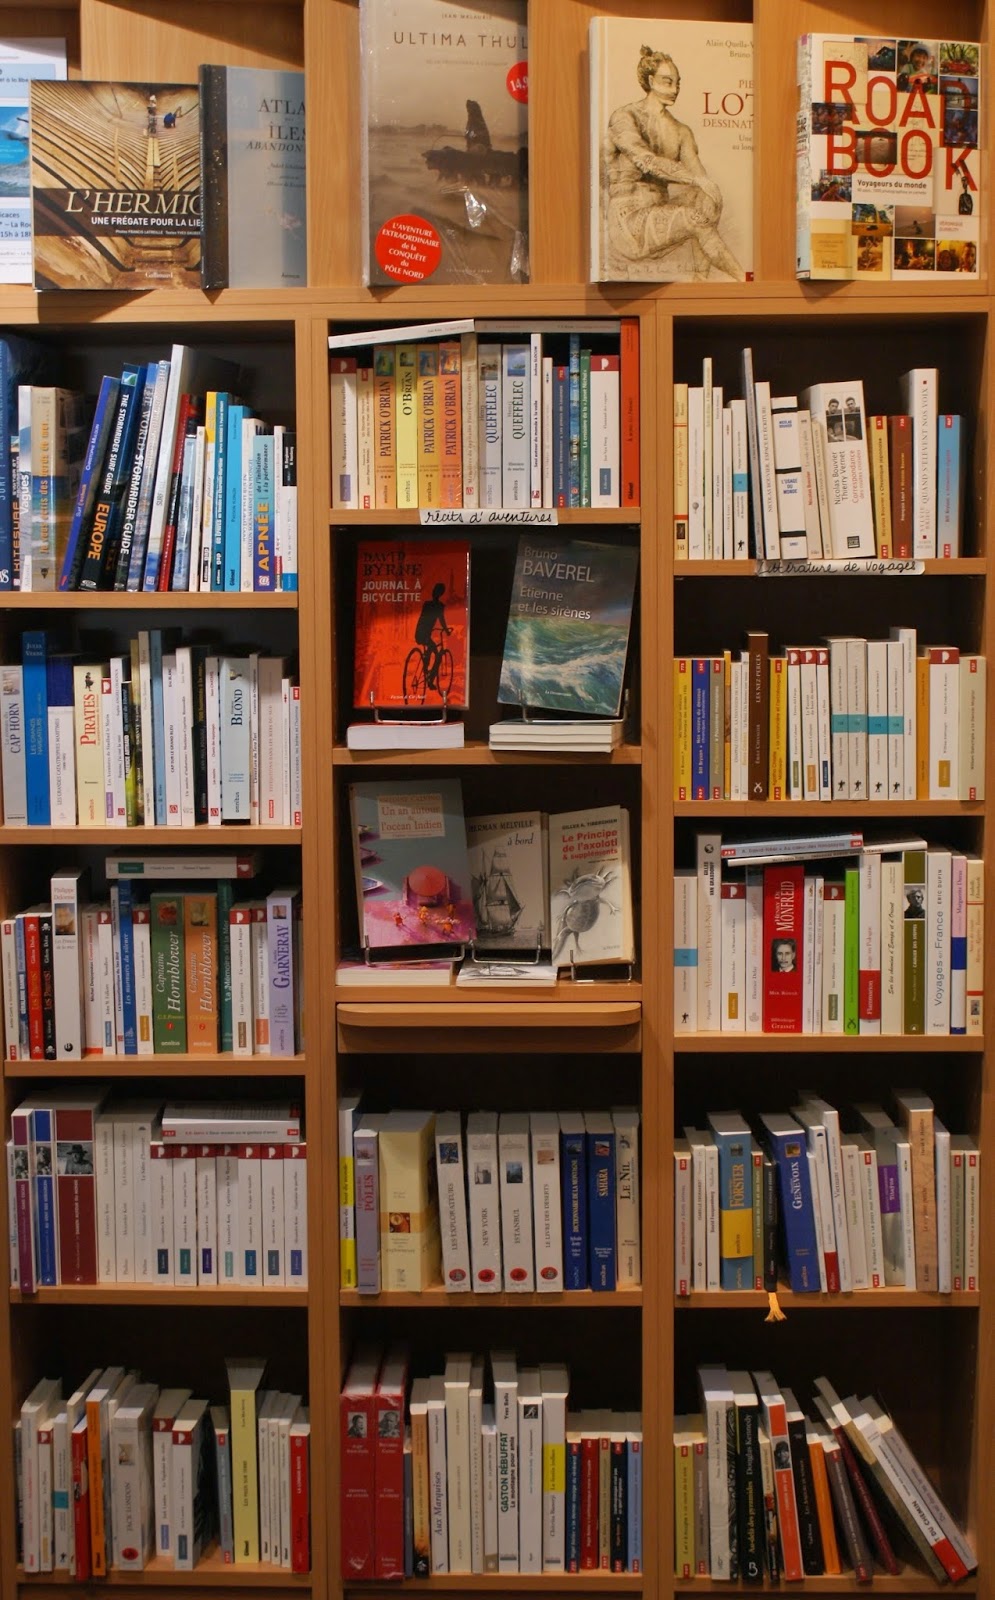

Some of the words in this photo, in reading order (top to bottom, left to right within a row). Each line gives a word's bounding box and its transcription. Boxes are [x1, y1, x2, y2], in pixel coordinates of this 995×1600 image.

[394, 32, 466, 46] ULTIMA
[706, 39, 724, 47] Alain
[824, 60, 972, 132] ROAD
[826, 127, 978, 191] BOOK
[857, 178, 892, 189] Voyageurs
[894, 180, 902, 188] du
[91, 216, 109, 225] UNE
[111, 216, 148, 226] FRÉGATE
[150, 218, 174, 226] POUR
[392, 222, 432, 237] L'AVENTURE
[382, 228, 440, 248] EXTRAORDINAIRE
[388, 248, 428, 262] CONQUÊTE
[400, 258, 410, 268] du
[384, 264, 402, 276] PÔLE
[402, 268, 424, 280] NORD
[121, 394, 130, 407] THE
[379, 382, 391, 418] O'BRIAN
[402, 372, 412, 416] O'BRIAN
[423, 380, 434, 416] O'BRIAN
[444, 380, 456, 416] O'BRIAN
[921, 388, 929, 408] VOIX
[111, 408, 127, 453] STORMRIDER
[380, 421, 392, 456] PATRICK
[424, 418, 434, 454] PATRICK
[445, 418, 456, 456] PATRICK
[108, 454, 118, 472] SURF
[831, 451, 840, 478] Bouvier
[39, 480, 49, 494] des
[104, 472, 114, 494] GUIDE
[126, 454, 144, 520] STORMRIDER
[840, 476, 849, 501] Thierry
[848, 450, 860, 504] Correspondance
[921, 475, 929, 504] QUAND
[20, 474, 32, 514] Vagues
[832, 479, 842, 504] Nicolas
[424, 509, 464, 524] récits
[488, 511, 552, 522] aventures
[88, 503, 110, 561] EUROPE
[120, 522, 133, 554] GUIDE
[255, 502, 270, 571] APNÉE
[524, 546, 558, 560] Bruno
[522, 560, 595, 583] BAVEREL
[844, 562, 860, 573] de
[865, 561, 916, 576] Voyages
[361, 592, 420, 603] BICYCLETTE
[362, 580, 410, 590] JOURNAL
[414, 578, 422, 590] À
[520, 586, 564, 601] Étienne
[518, 602, 530, 612] et
[532, 602, 548, 615] les
[551, 606, 591, 620] sirènes
[9, 703, 20, 731] HORN
[80, 694, 96, 746] PIRATES
[230, 689, 243, 726] BLOND
[10, 734, 21, 754] CAP
[382, 806, 395, 816] Un
[500, 820, 534, 829] MELVILLE
[381, 822, 411, 831] l'océan
[415, 821, 442, 830] Indien
[515, 833, 534, 846] bord
[562, 834, 574, 843] Le
[576, 829, 618, 841] Principe
[562, 844, 574, 853] de
[570, 848, 618, 860] suppléments
[776, 881, 795, 932] MONFREID
[887, 931, 895, 955] d'Europe
[934, 911, 943, 950] France
[124, 955, 130, 964] du
[272, 926, 291, 989] GARNERAY
[156, 952, 166, 993] Capitaine
[167, 932, 181, 1012] Hornblower
[188, 952, 198, 994] Capitaine
[199, 932, 213, 1013] Hornblower
[934, 961, 944, 1006] Voyages
[866, 981, 874, 1015] Flammarion
[598, 1169, 608, 1197] SAHARA
[619, 1162, 630, 1182] NIL
[729, 1164, 745, 1207] FORSTER
[791, 1161, 803, 1209] GENEVOIX
[831, 1172, 841, 1198] Vietnam
[620, 1185, 631, 1200] LE
[447, 1183, 457, 1237] EXPLORATEURS
[513, 1208, 521, 1244] ISTANBUL
[743, 1414, 753, 1445] Kennedy
[499, 1432, 508, 1475] RÉBUFFAT
[745, 1447, 754, 1475] Douglas
[124, 1482, 133, 1512] LONDON
[433, 1472, 443, 1515] Marquises
[501, 1478, 509, 1512] GASTON
[746, 1481, 756, 1515] pyramides
[434, 1516, 442, 1536] Aux
[747, 1516, 756, 1527] des
[747, 1529, 756, 1553] Au-delà
